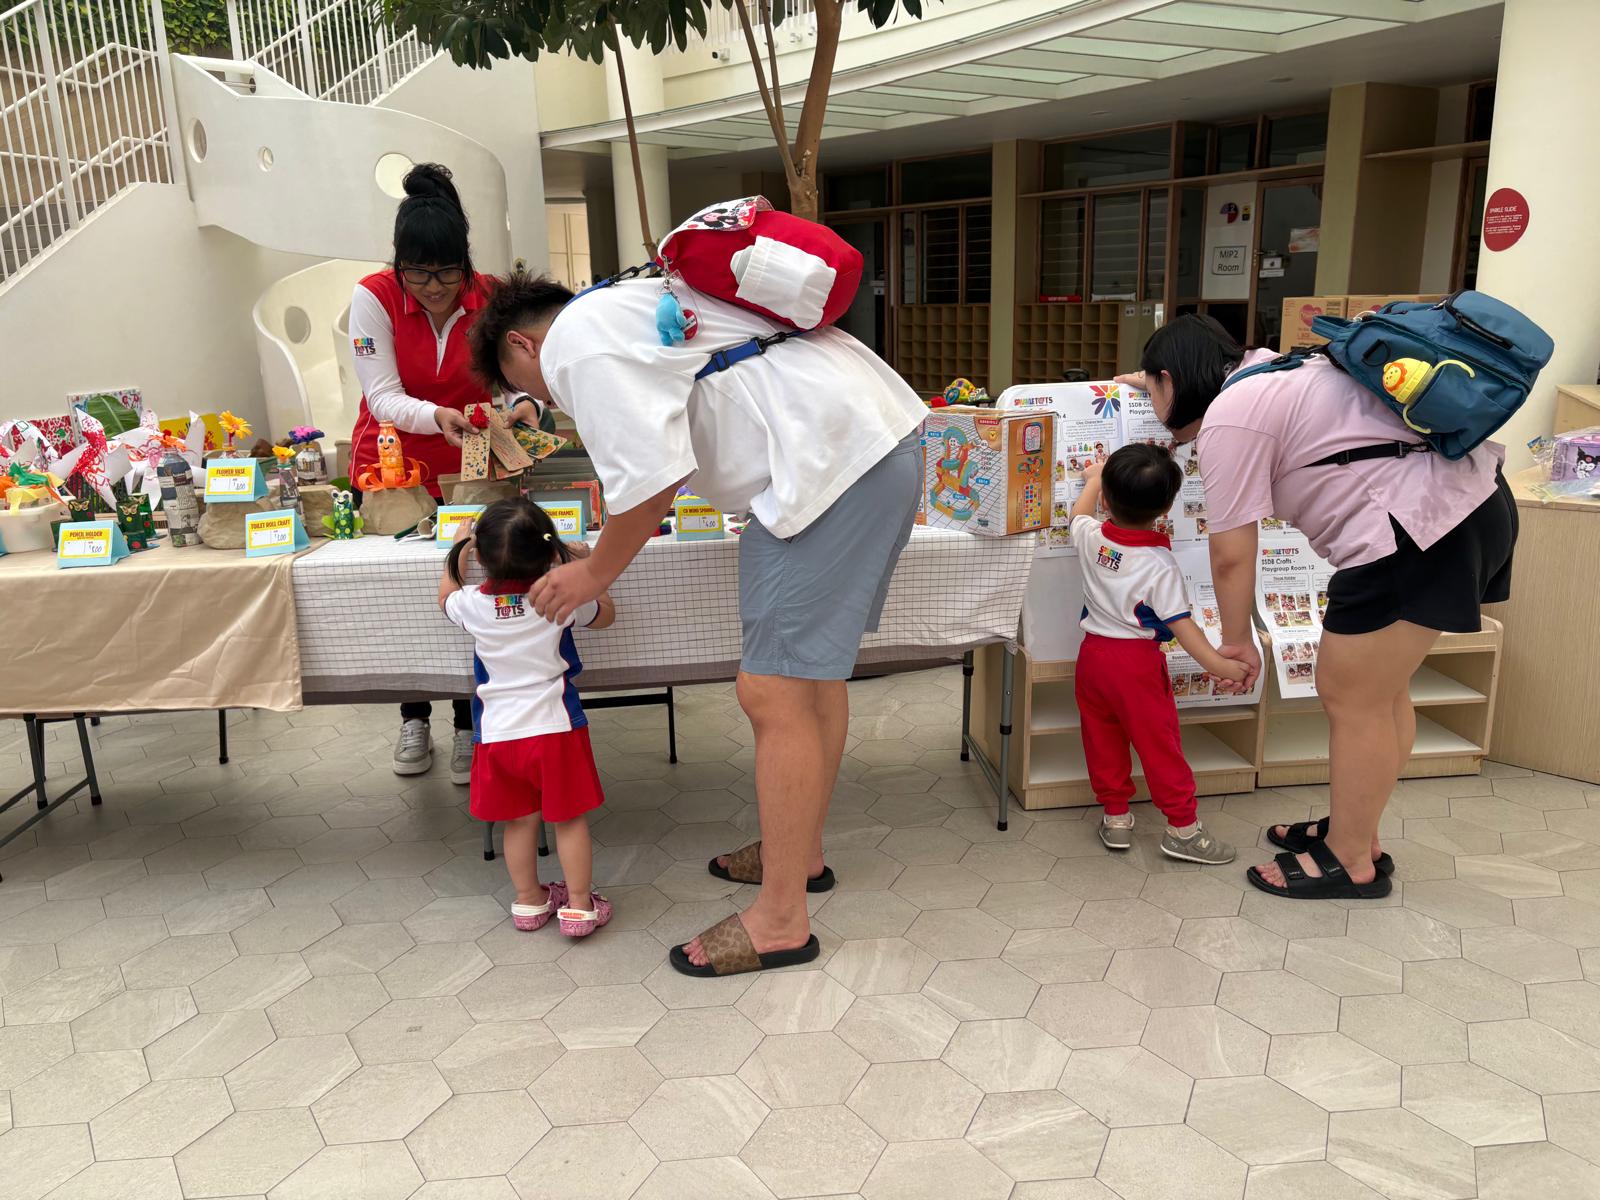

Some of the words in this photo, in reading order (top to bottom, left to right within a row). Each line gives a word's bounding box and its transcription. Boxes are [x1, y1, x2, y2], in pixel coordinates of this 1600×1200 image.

[1219, 250, 1238, 258] MIP2
[1217, 263, 1240, 272] Room
[494, 605, 525, 616] TOTS
